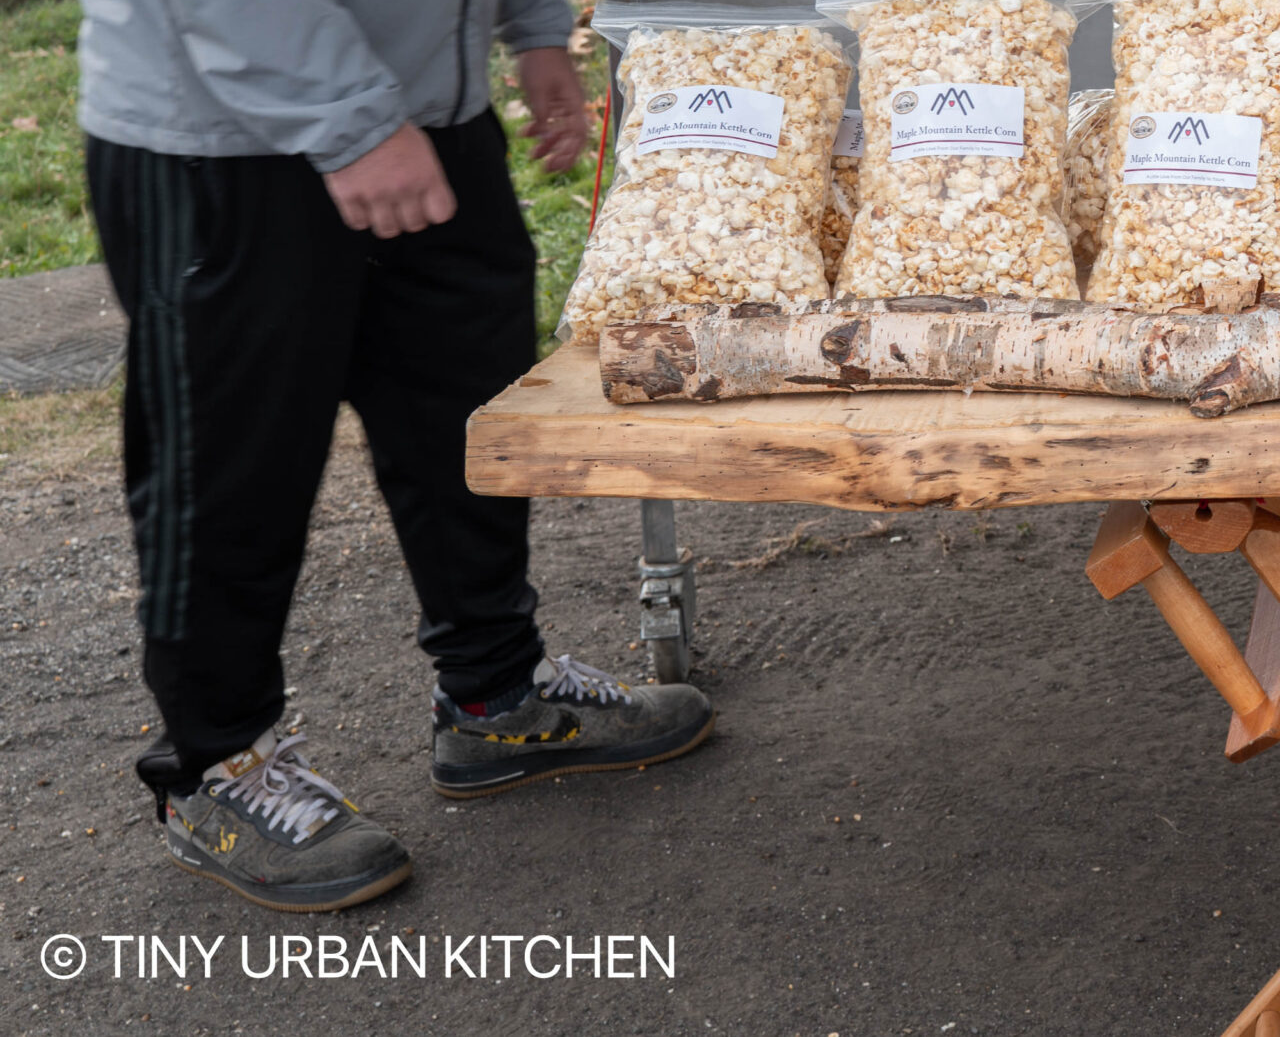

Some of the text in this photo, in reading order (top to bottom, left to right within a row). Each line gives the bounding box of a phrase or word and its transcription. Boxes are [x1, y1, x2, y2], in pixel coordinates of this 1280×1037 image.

[646, 121, 773, 140] Maple Mountain Kettle Corn
[897, 125, 1017, 140] Maple Mountain Kettle Corn
[1130, 153, 1251, 168] Maple Mountain Kettle Corn
